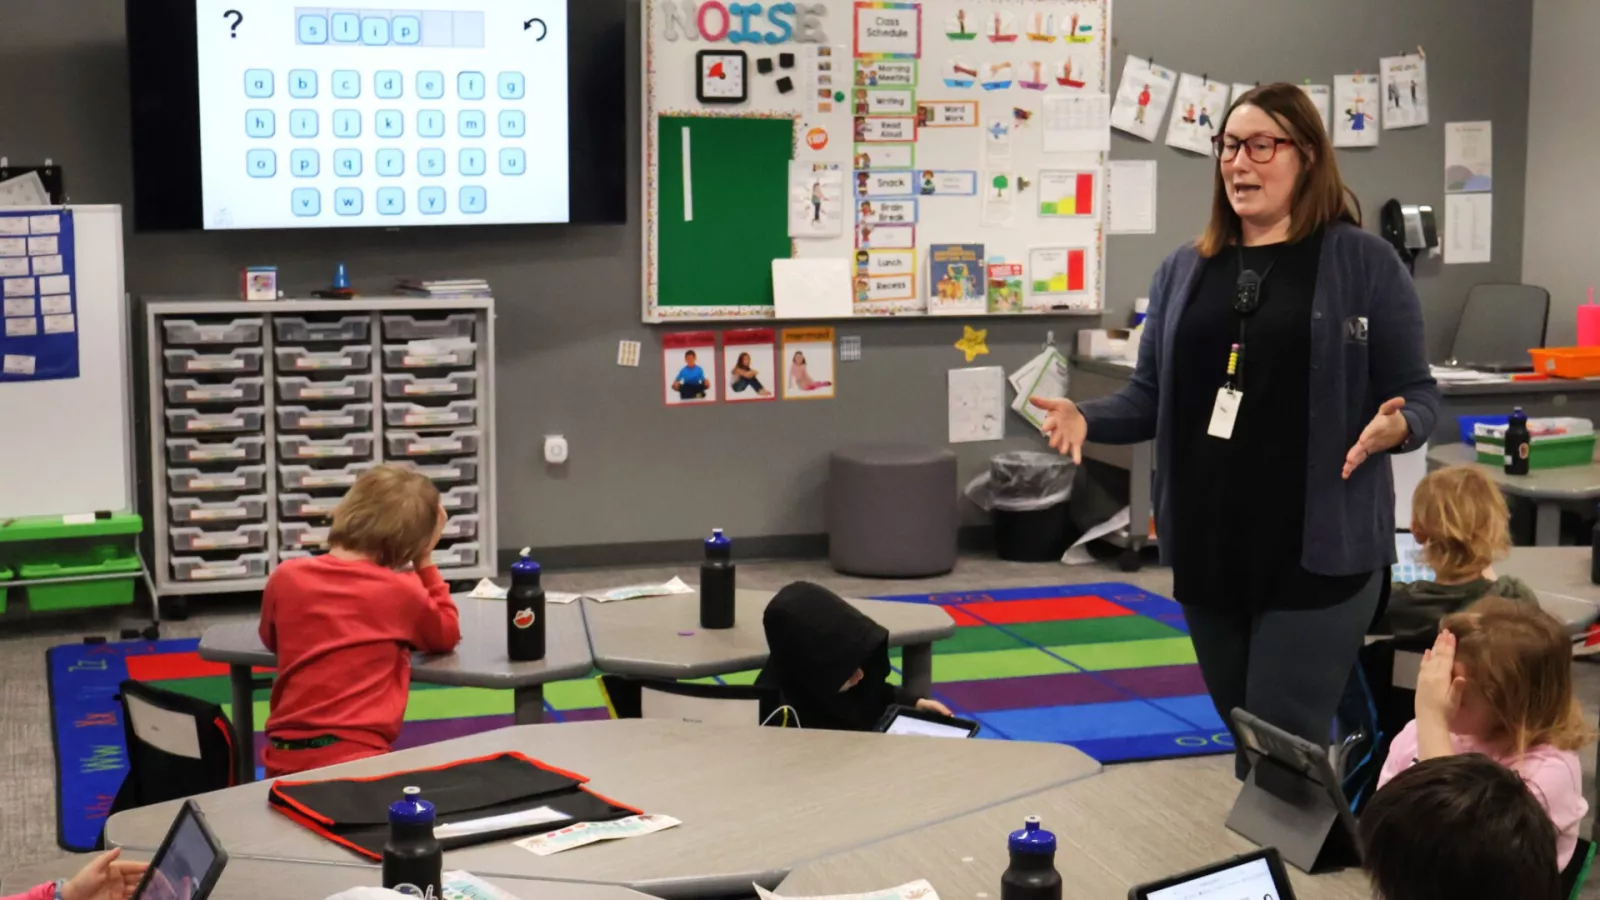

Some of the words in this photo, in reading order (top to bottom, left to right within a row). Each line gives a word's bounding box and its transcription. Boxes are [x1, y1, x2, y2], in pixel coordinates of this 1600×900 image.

[661, 1, 829, 44] NOISE
[875, 16, 899, 26] Class
[866, 28, 908, 37] Schedule
[878, 65, 910, 74] Morning
[878, 75, 910, 83] Meeting
[254, 80, 263, 89] a
[299, 78, 307, 89] b
[341, 81, 349, 89] c
[384, 79, 393, 91] d
[425, 82, 433, 90] e
[507, 83, 515, 93] g
[876, 97, 904, 106] Writing
[256, 118, 264, 128] h
[386, 119, 393, 129] k
[881, 121, 901, 129] Read
[880, 130, 902, 138] Aloud
[301, 161, 309, 170] p
[344, 160, 351, 170] q
[877, 178, 905, 187] Snack
[302, 199, 309, 207] v
[343, 199, 354, 207] w
[387, 198, 394, 207] x
[428, 199, 436, 208] y
[469, 196, 476, 205] z
[881, 203, 903, 211] Brain
[879, 213, 905, 221] Break
[877, 259, 902, 267] Lunch
[876, 281, 906, 290] Recess
